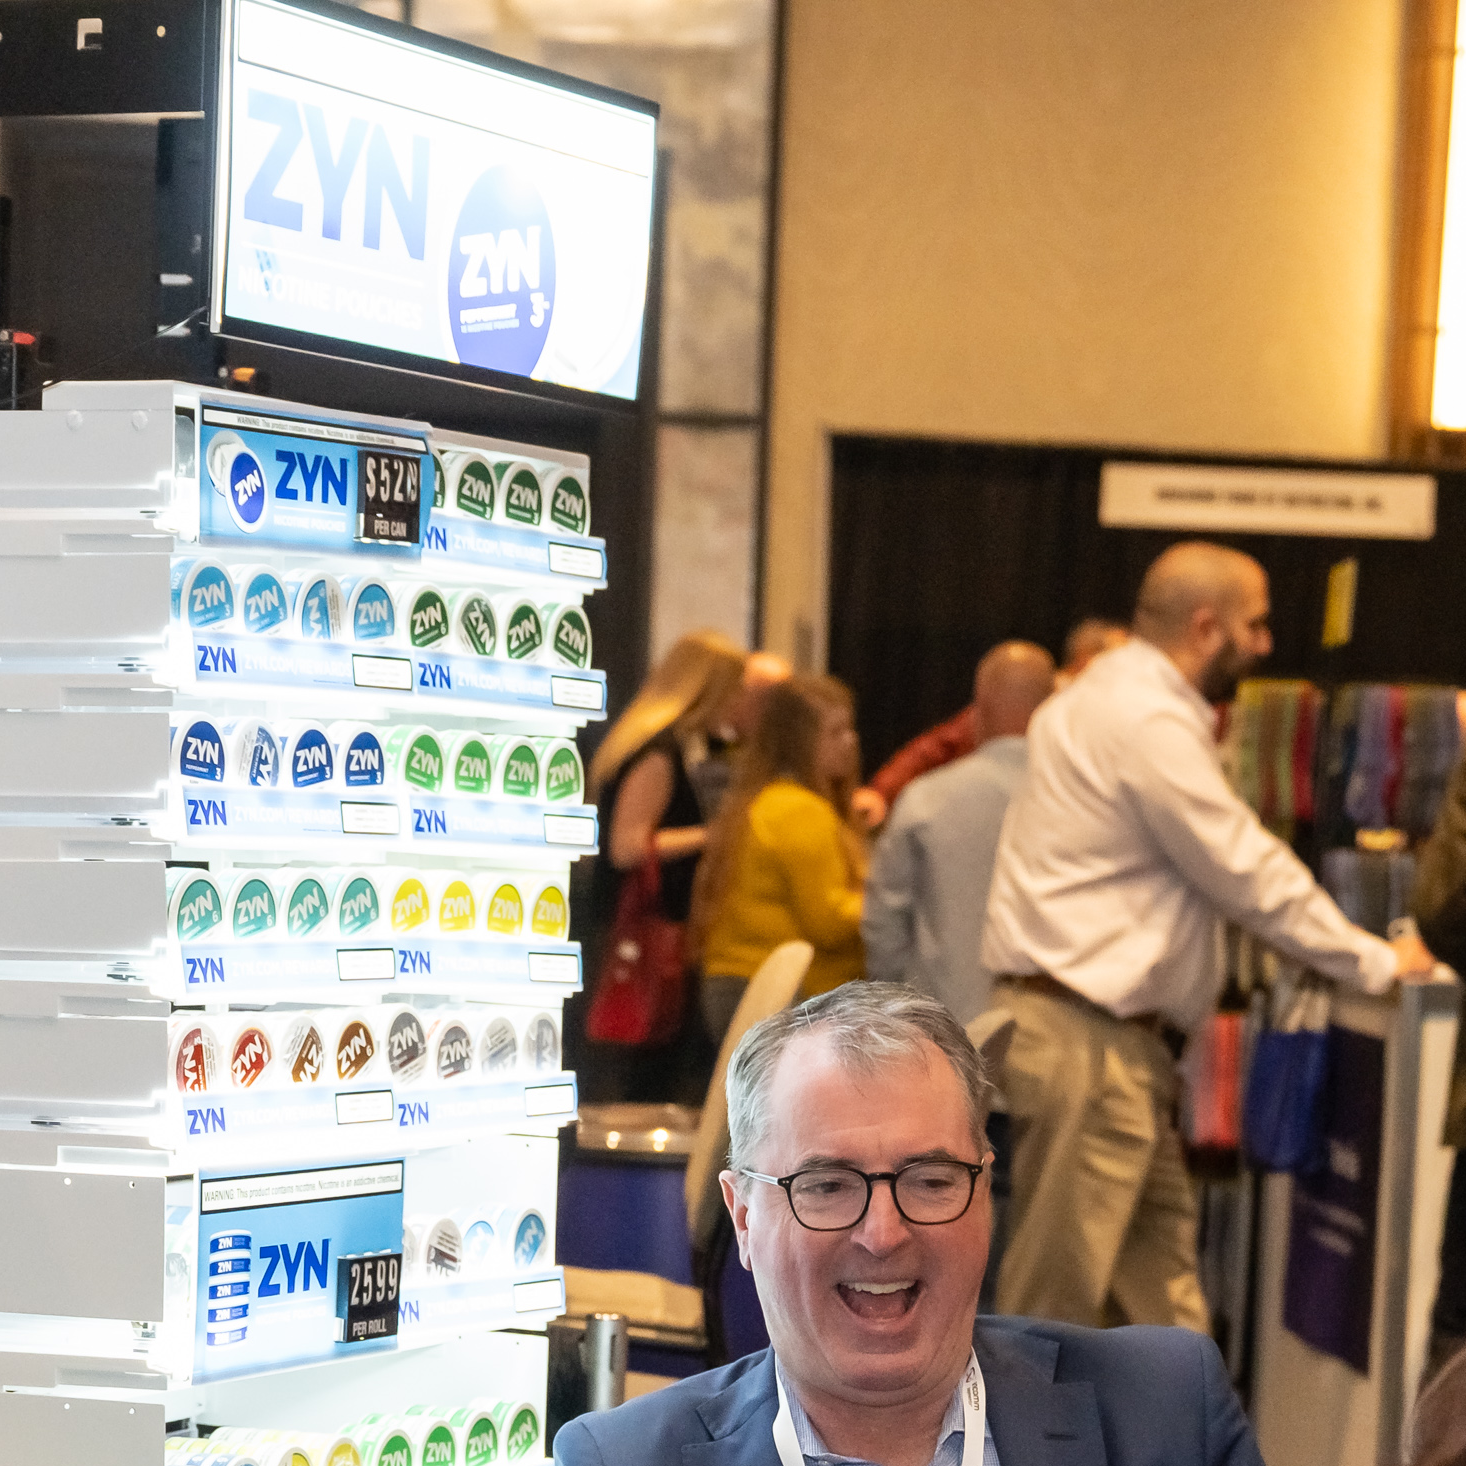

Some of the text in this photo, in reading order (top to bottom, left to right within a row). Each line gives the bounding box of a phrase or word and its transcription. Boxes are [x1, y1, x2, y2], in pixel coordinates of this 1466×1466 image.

[244, 88, 430, 261] ZYN
[459, 225, 541, 298] ZYN
[237, 264, 330, 312] NICOTINE
[335, 286, 423, 330] POUCHES
[235, 470, 261, 506] ZYN
[275, 450, 347, 506] ZYN
[461, 474, 491, 504] ZYN
[509, 483, 538, 511] ZYN
[555, 488, 583, 519] ZYN
[374, 520, 407, 537] PER CAN
[424, 527, 447, 551] YN
[193, 581, 226, 612] ZYN
[247, 586, 279, 620] ZYN
[358, 600, 388, 625] ZYN
[413, 603, 443, 635] ZYN
[509, 615, 537, 647] ZYN
[559, 619, 586, 654] ZYN
[197, 645, 237, 673] ZYN
[419, 663, 452, 690] ZYN
[187, 737, 219, 765] ZYN
[296, 744, 327, 772] ZYN
[349, 749, 379, 771] ZYN
[411, 747, 440, 777] ZYN
[215, 767, 221, 780] 3
[325, 767, 330, 779] 3
[376, 772, 382, 784] 3
[459, 755, 487, 779] ZYN
[508, 760, 535, 783] ZYN
[549, 761, 575, 788] ZYN
[187, 799, 227, 825] ZYN
[413, 809, 447, 834] ZYN
[180, 889, 213, 930] ZYN
[212, 910, 218, 922] 6
[237, 892, 269, 926] ZYN
[267, 914, 273, 927] 6
[289, 886, 321, 931] ZYN
[342, 888, 372, 925] ZYN
[394, 889, 422, 924] ZYN
[443, 895, 470, 919] ZYN
[492, 898, 519, 922] ZYN
[186, 957, 225, 983] ZYN
[399, 950, 431, 974] ZYN
[338, 1028, 367, 1073] ZYN
[390, 1022, 419, 1057] ZYN
[440, 1038, 468, 1067] ZYN
[232, 1033, 262, 1086] ZYN
[187, 1107, 226, 1135] ZYN
[398, 1102, 429, 1127] ZYN
[218, 1237, 233, 1249] ZYN
[217, 1260, 232, 1273] ZYN
[258, 1239, 329, 1297] ZYN
[350, 1258, 398, 1306] 2599
[399, 1300, 420, 1324] YN
[353, 1318, 387, 1336] PER ROLL
[425, 1442, 452, 1462] ZYN
[468, 1430, 493, 1458] ZYN
